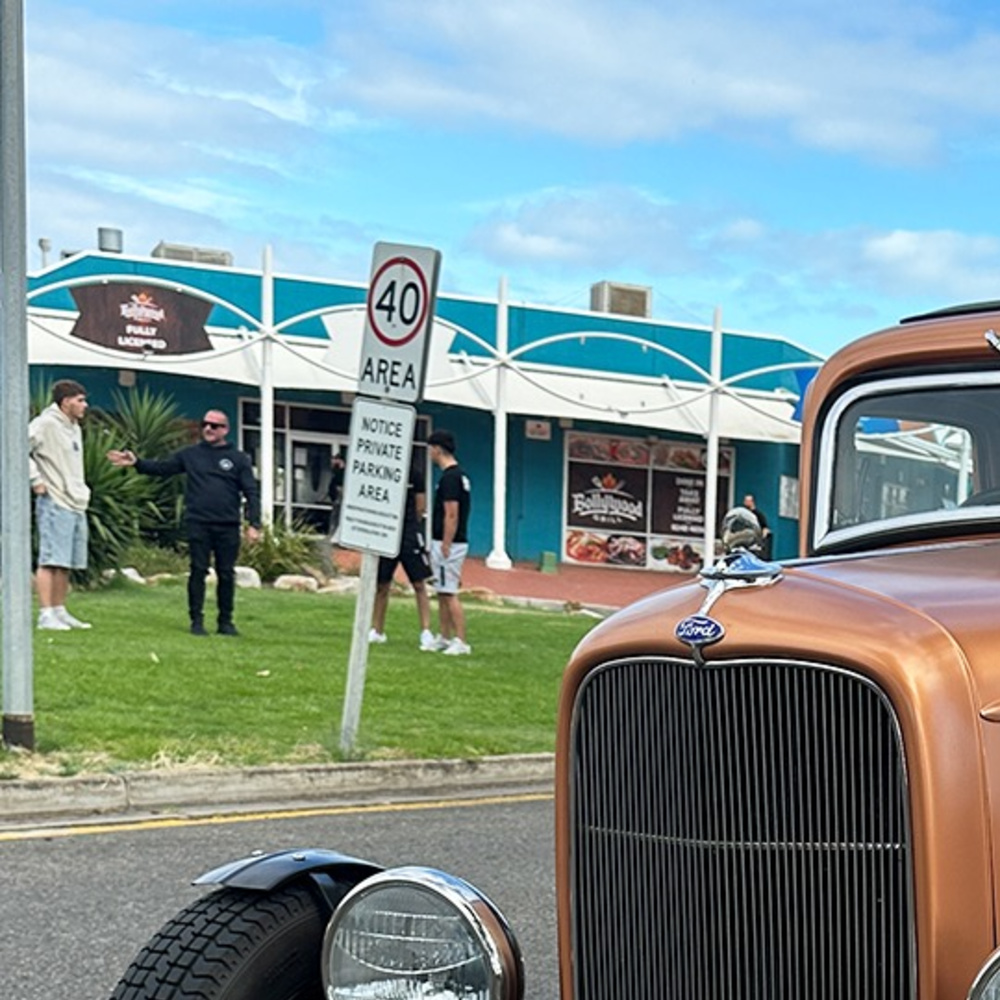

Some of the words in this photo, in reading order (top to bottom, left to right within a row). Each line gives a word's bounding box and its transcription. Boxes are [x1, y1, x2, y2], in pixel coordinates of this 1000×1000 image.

[375, 280, 421, 326] 40
[126, 325, 157, 336] FULLY
[361, 357, 416, 389] AREA
[361, 416, 403, 438] NOTICE
[356, 438, 403, 460] PRIVATE
[352, 460, 401, 483] PARKING
[358, 484, 390, 504] AREA
[572, 493, 643, 518] Bollywood
[677, 620, 717, 637] Ford
